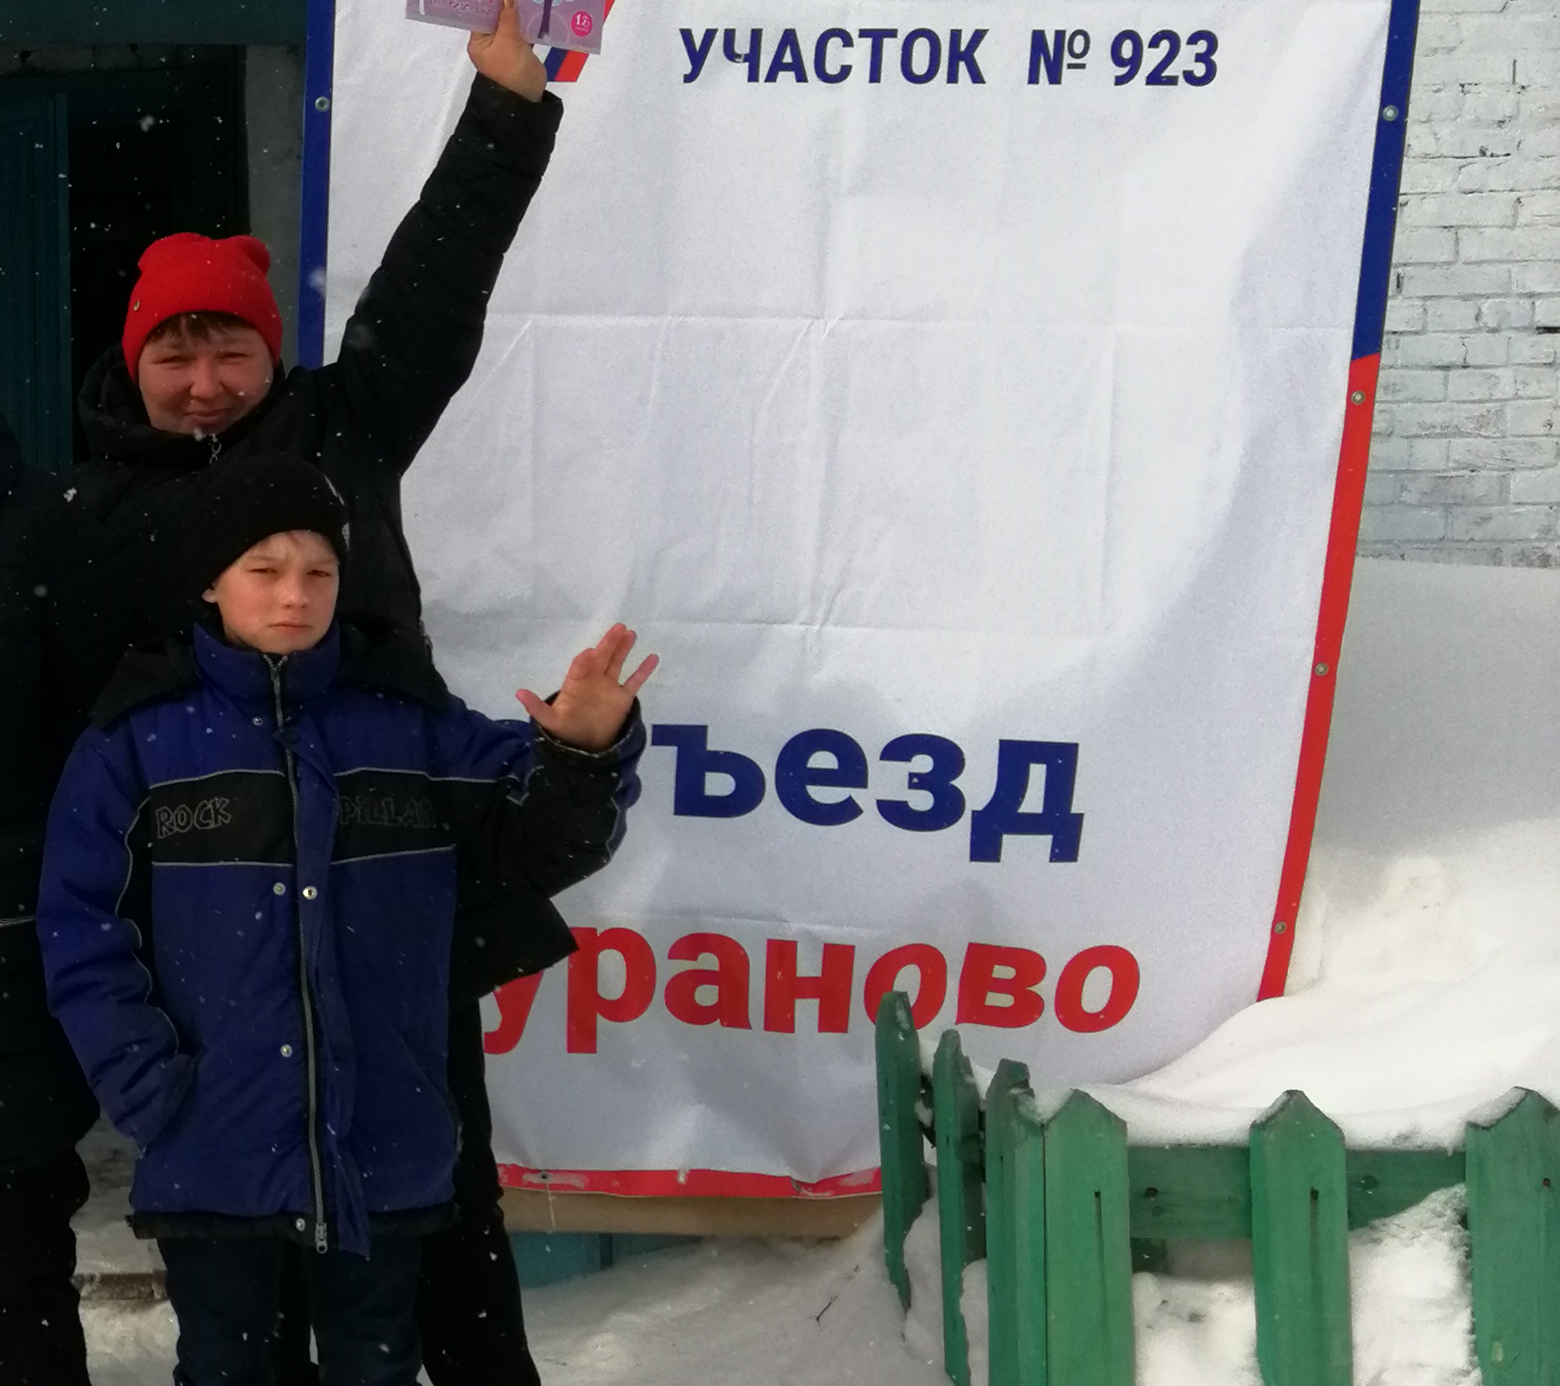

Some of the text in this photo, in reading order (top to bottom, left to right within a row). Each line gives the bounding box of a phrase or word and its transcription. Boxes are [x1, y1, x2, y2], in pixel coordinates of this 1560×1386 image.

[679, 28, 1218, 87] УЧАСТОК № 923
[155, 797, 233, 838] ROCK
[650, 723, 1085, 863] ъезд
[483, 927, 1140, 1055] ураново
